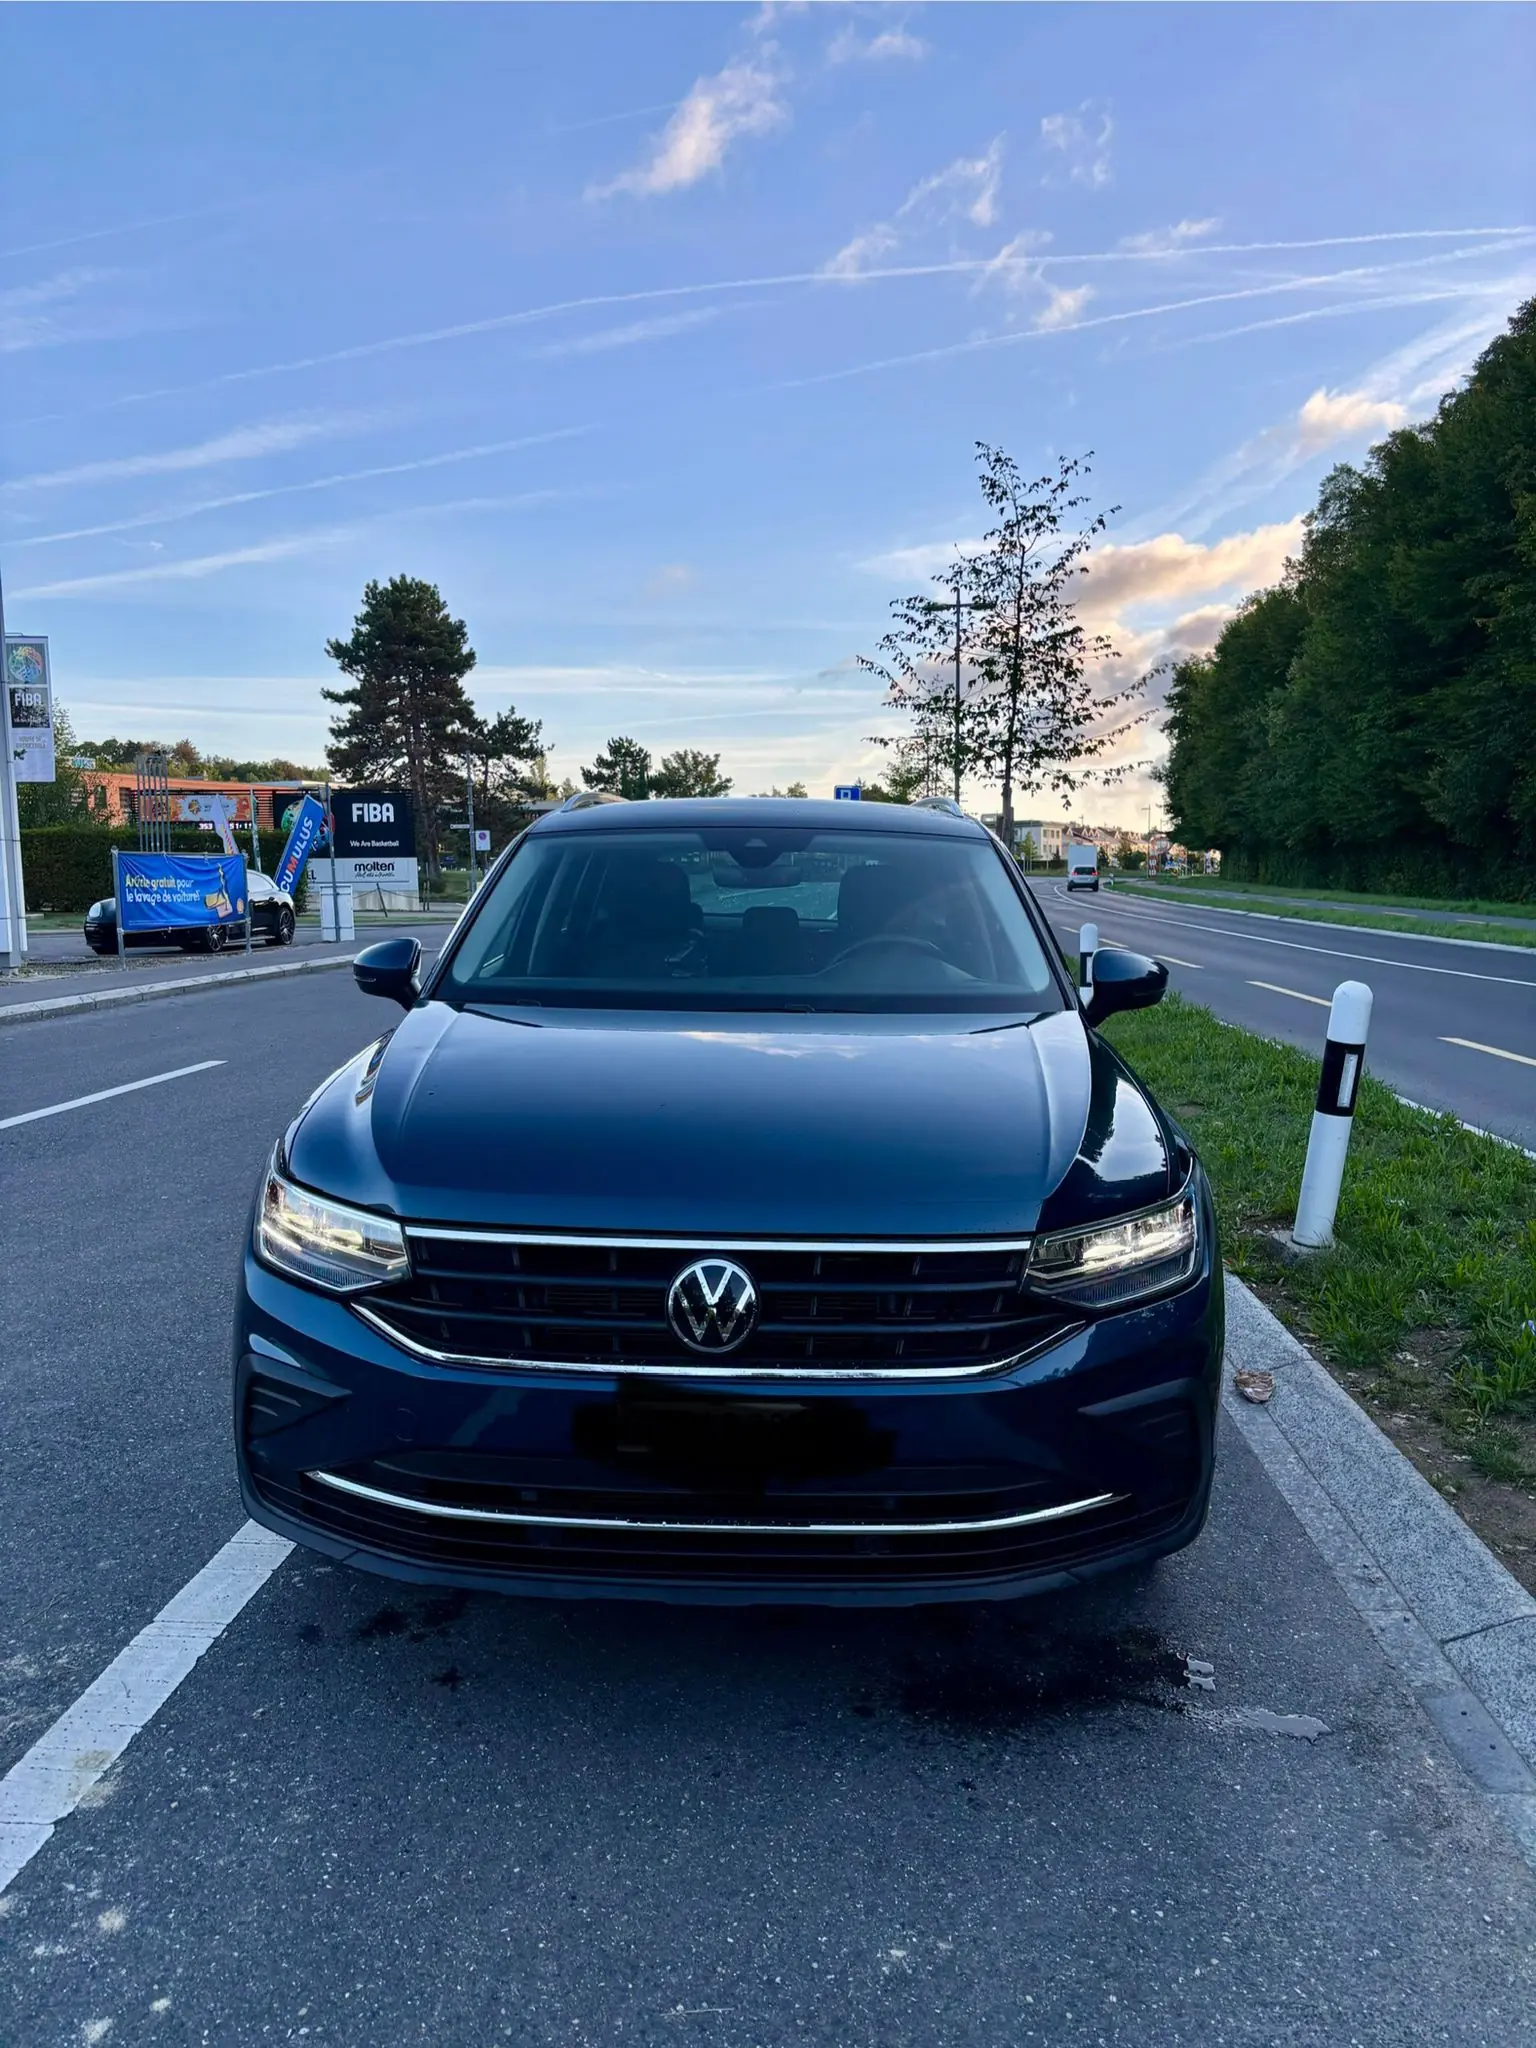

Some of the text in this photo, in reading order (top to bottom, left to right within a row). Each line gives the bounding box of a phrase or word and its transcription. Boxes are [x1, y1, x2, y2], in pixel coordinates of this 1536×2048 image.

[14, 692, 42, 707] FIBA
[352, 803, 395, 823] FIBA
[280, 816, 313, 893] CUMULUS
[354, 861, 395, 872] molten
[151, 875, 176, 891] gratuit
[176, 879, 194, 891] pour
[126, 889, 134, 903] le
[134, 889, 162, 906] lavage
[162, 890, 172, 903] de
